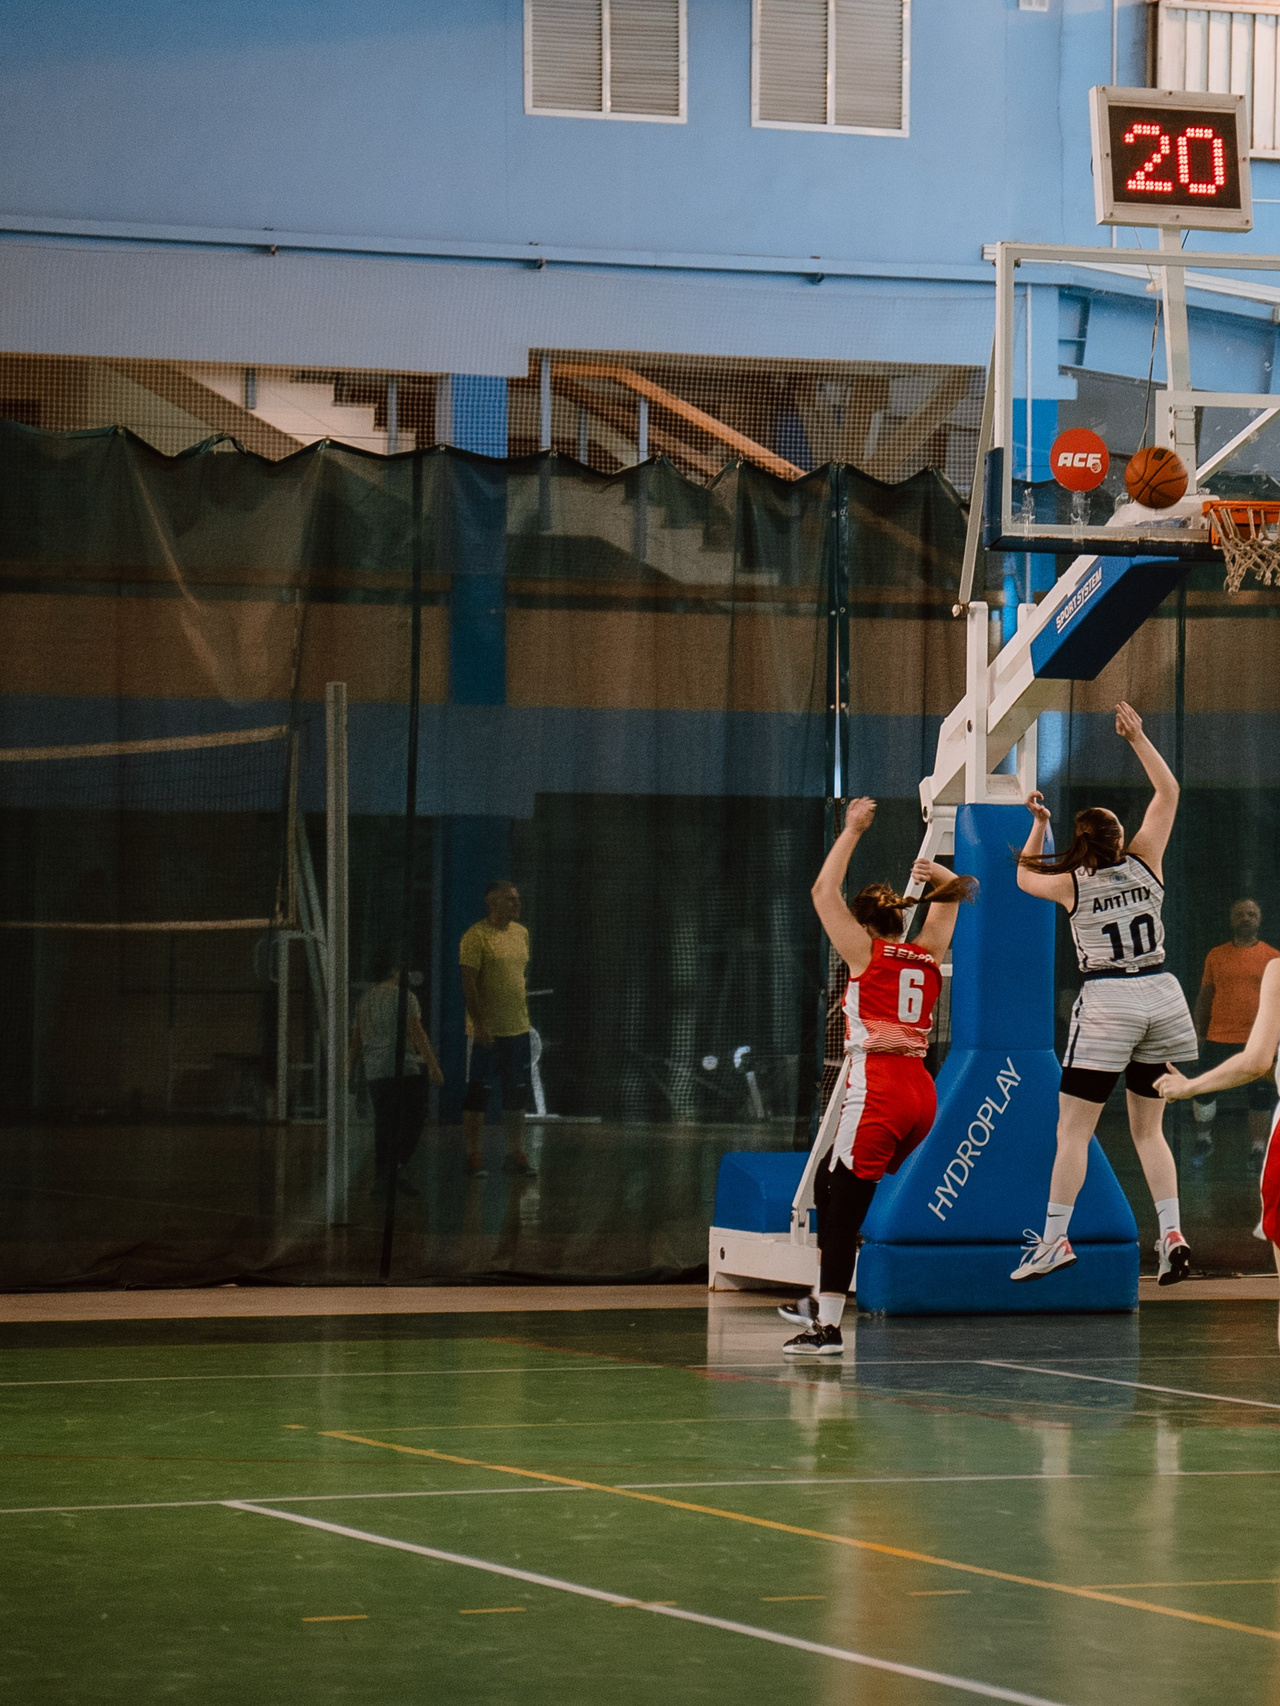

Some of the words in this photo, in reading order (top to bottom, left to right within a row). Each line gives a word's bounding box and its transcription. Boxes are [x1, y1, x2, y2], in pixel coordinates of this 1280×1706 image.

[1123, 123, 1226, 195] 20
[1057, 452, 1102, 473] АСБ
[1092, 886, 1151, 914] АлтГПУ
[1101, 913, 1158, 962] 10
[897, 968, 925, 1024] 6
[927, 1056, 1022, 1222] HYDROPLAY
